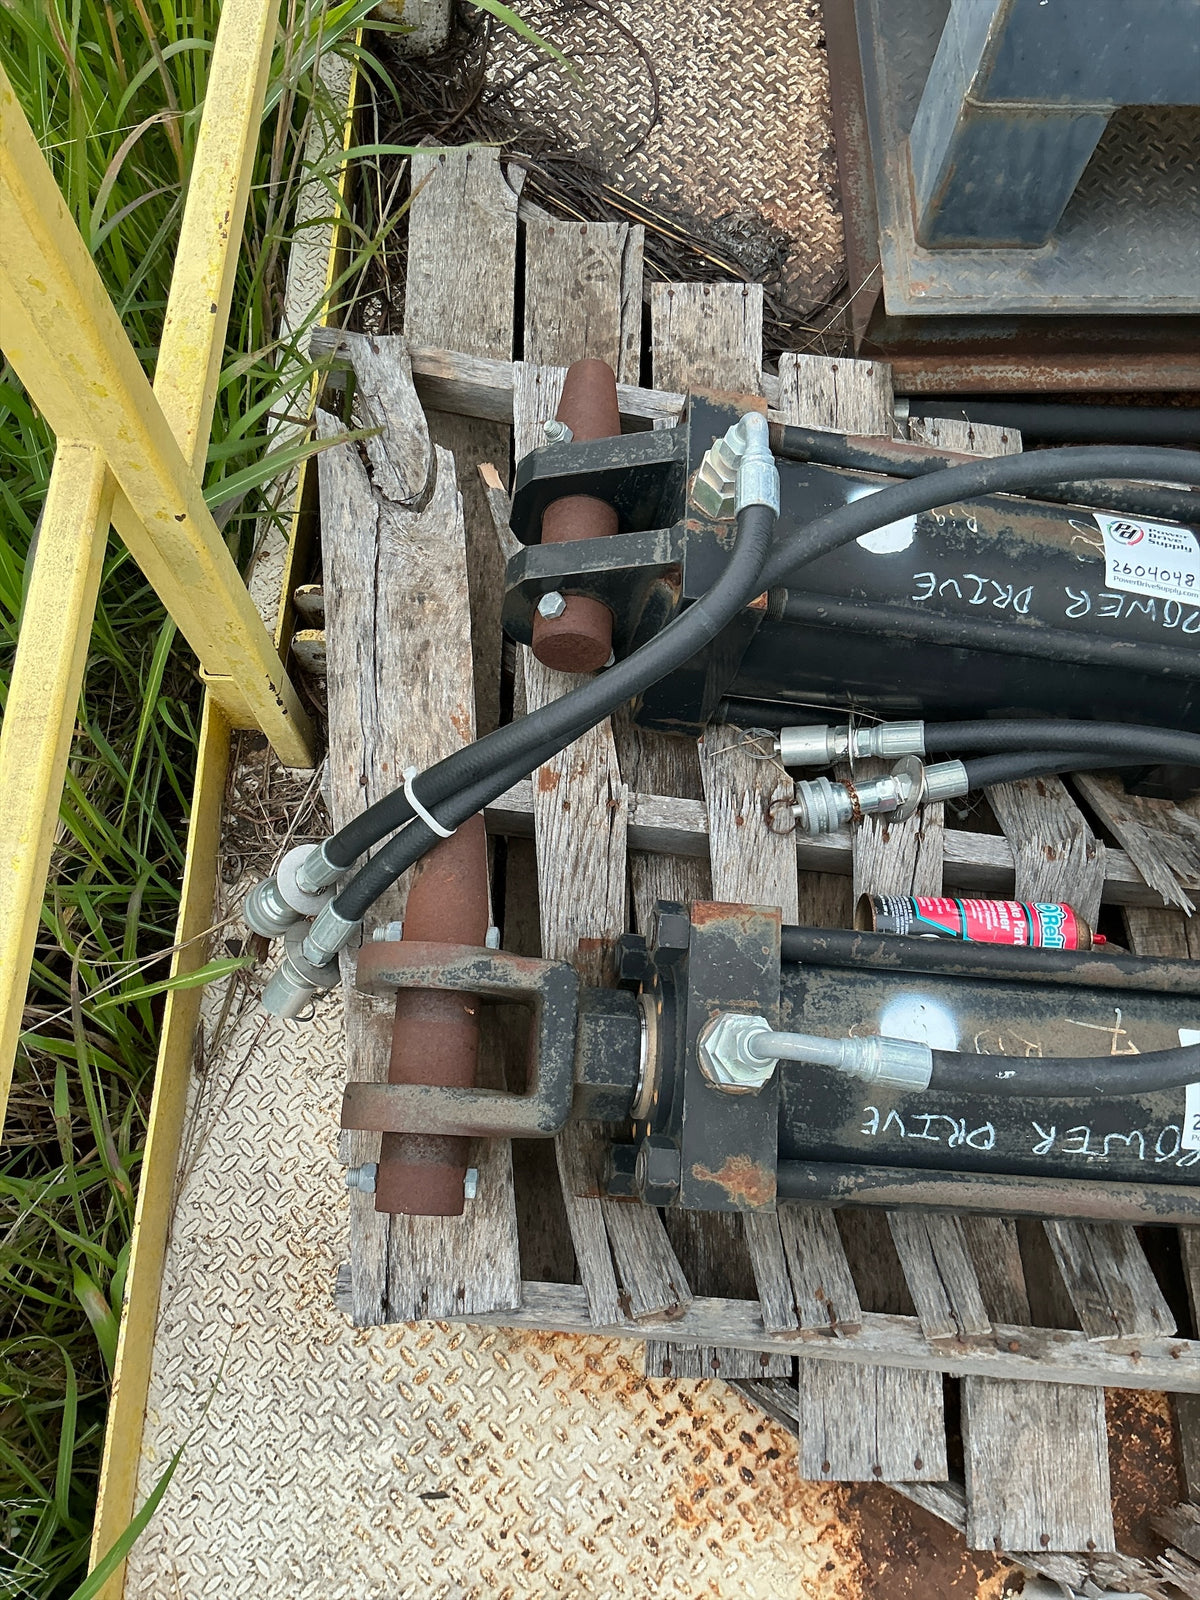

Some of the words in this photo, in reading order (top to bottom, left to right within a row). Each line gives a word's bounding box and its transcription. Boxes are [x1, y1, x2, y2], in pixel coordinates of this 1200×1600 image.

[1148, 528, 1189, 539] Power
[1148, 532, 1182, 543] Drive
[1148, 538, 1193, 553] Supply
[1112, 559, 1196, 587] 2604048
[912, 571, 1034, 614] DRIVE
[1113, 575, 1199, 599] PowerDriveSupply.com
[993, 900, 1012, 931] leaner
[1035, 902, 1064, 947] O'Reil
[1013, 920, 1026, 945] Part
[860, 1105, 996, 1150] DRIVE
